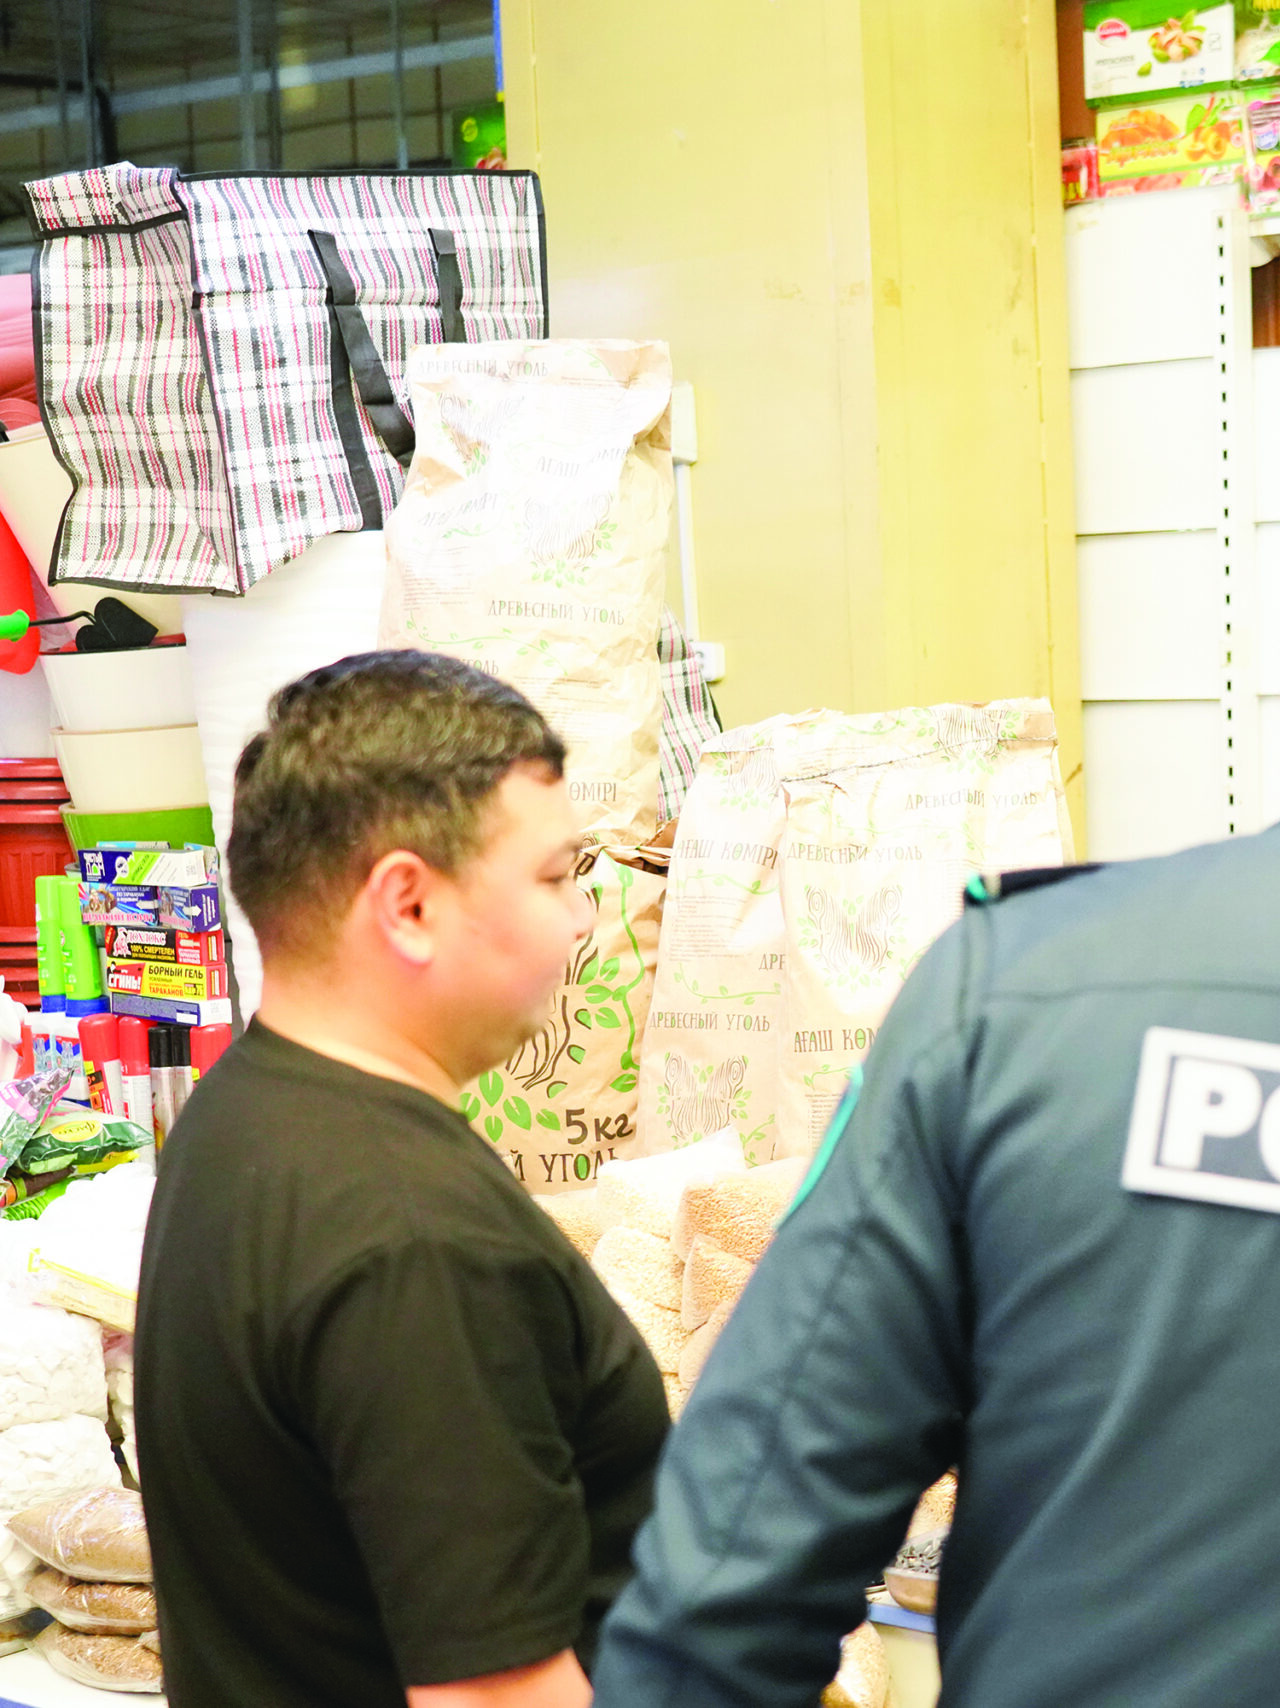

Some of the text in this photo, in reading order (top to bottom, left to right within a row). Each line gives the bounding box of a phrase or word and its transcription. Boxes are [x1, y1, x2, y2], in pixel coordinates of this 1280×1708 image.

[507, 360, 549, 377] УГОЛЬ
[488, 600, 625, 625] ДРЕВЕСНЫЙ УГОЛЬ
[569, 782, 617, 801] ӨМІРІ
[877, 846, 923, 862] УГОЛЬ
[148, 965, 204, 979] БОРНЫЙ ГЕЛЬ
[149, 986, 184, 996] ТАРАКАНОВ
[649, 1011, 770, 1032] ДРЕВЕСНЫЙ УГОЛЬ
